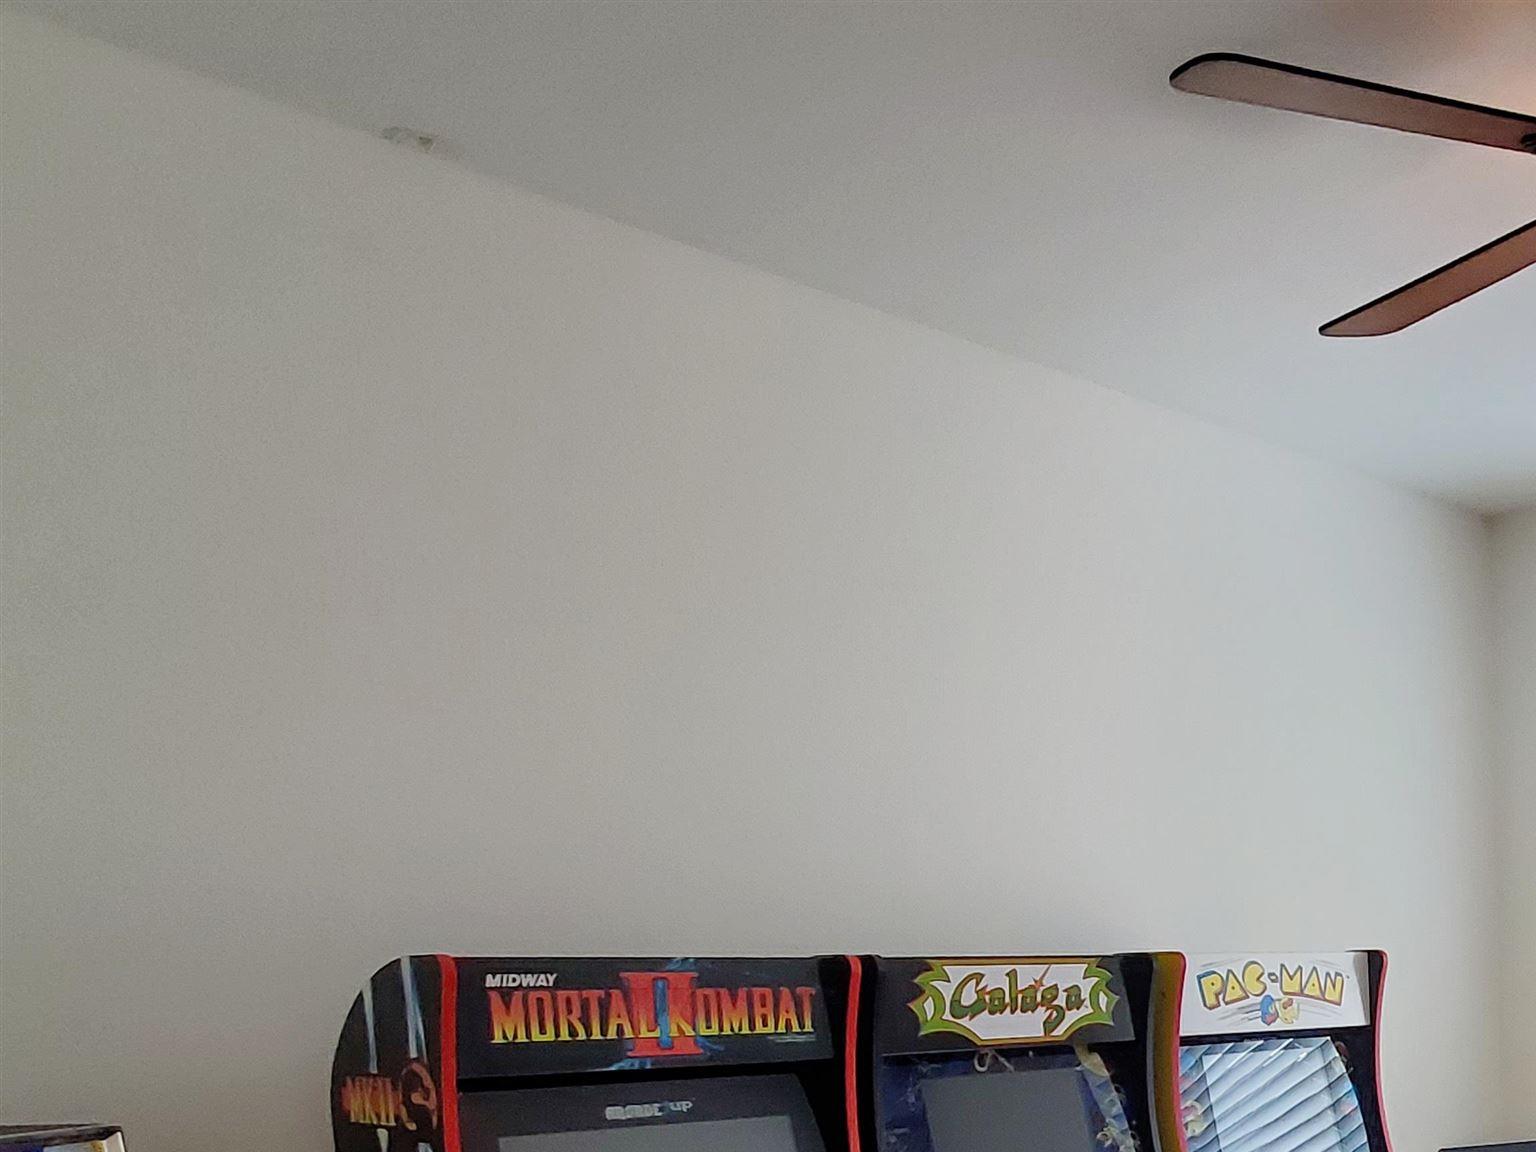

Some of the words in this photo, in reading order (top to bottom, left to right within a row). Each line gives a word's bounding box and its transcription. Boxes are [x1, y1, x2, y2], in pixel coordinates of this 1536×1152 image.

[485, 974, 557, 988] MIDWAY
[950, 966, 1088, 1037] Galaga
[1197, 960, 1345, 1010] PAC-MAN
[487, 987, 662, 1044] MORTAL
[668, 986, 816, 1037] KOMBAT
